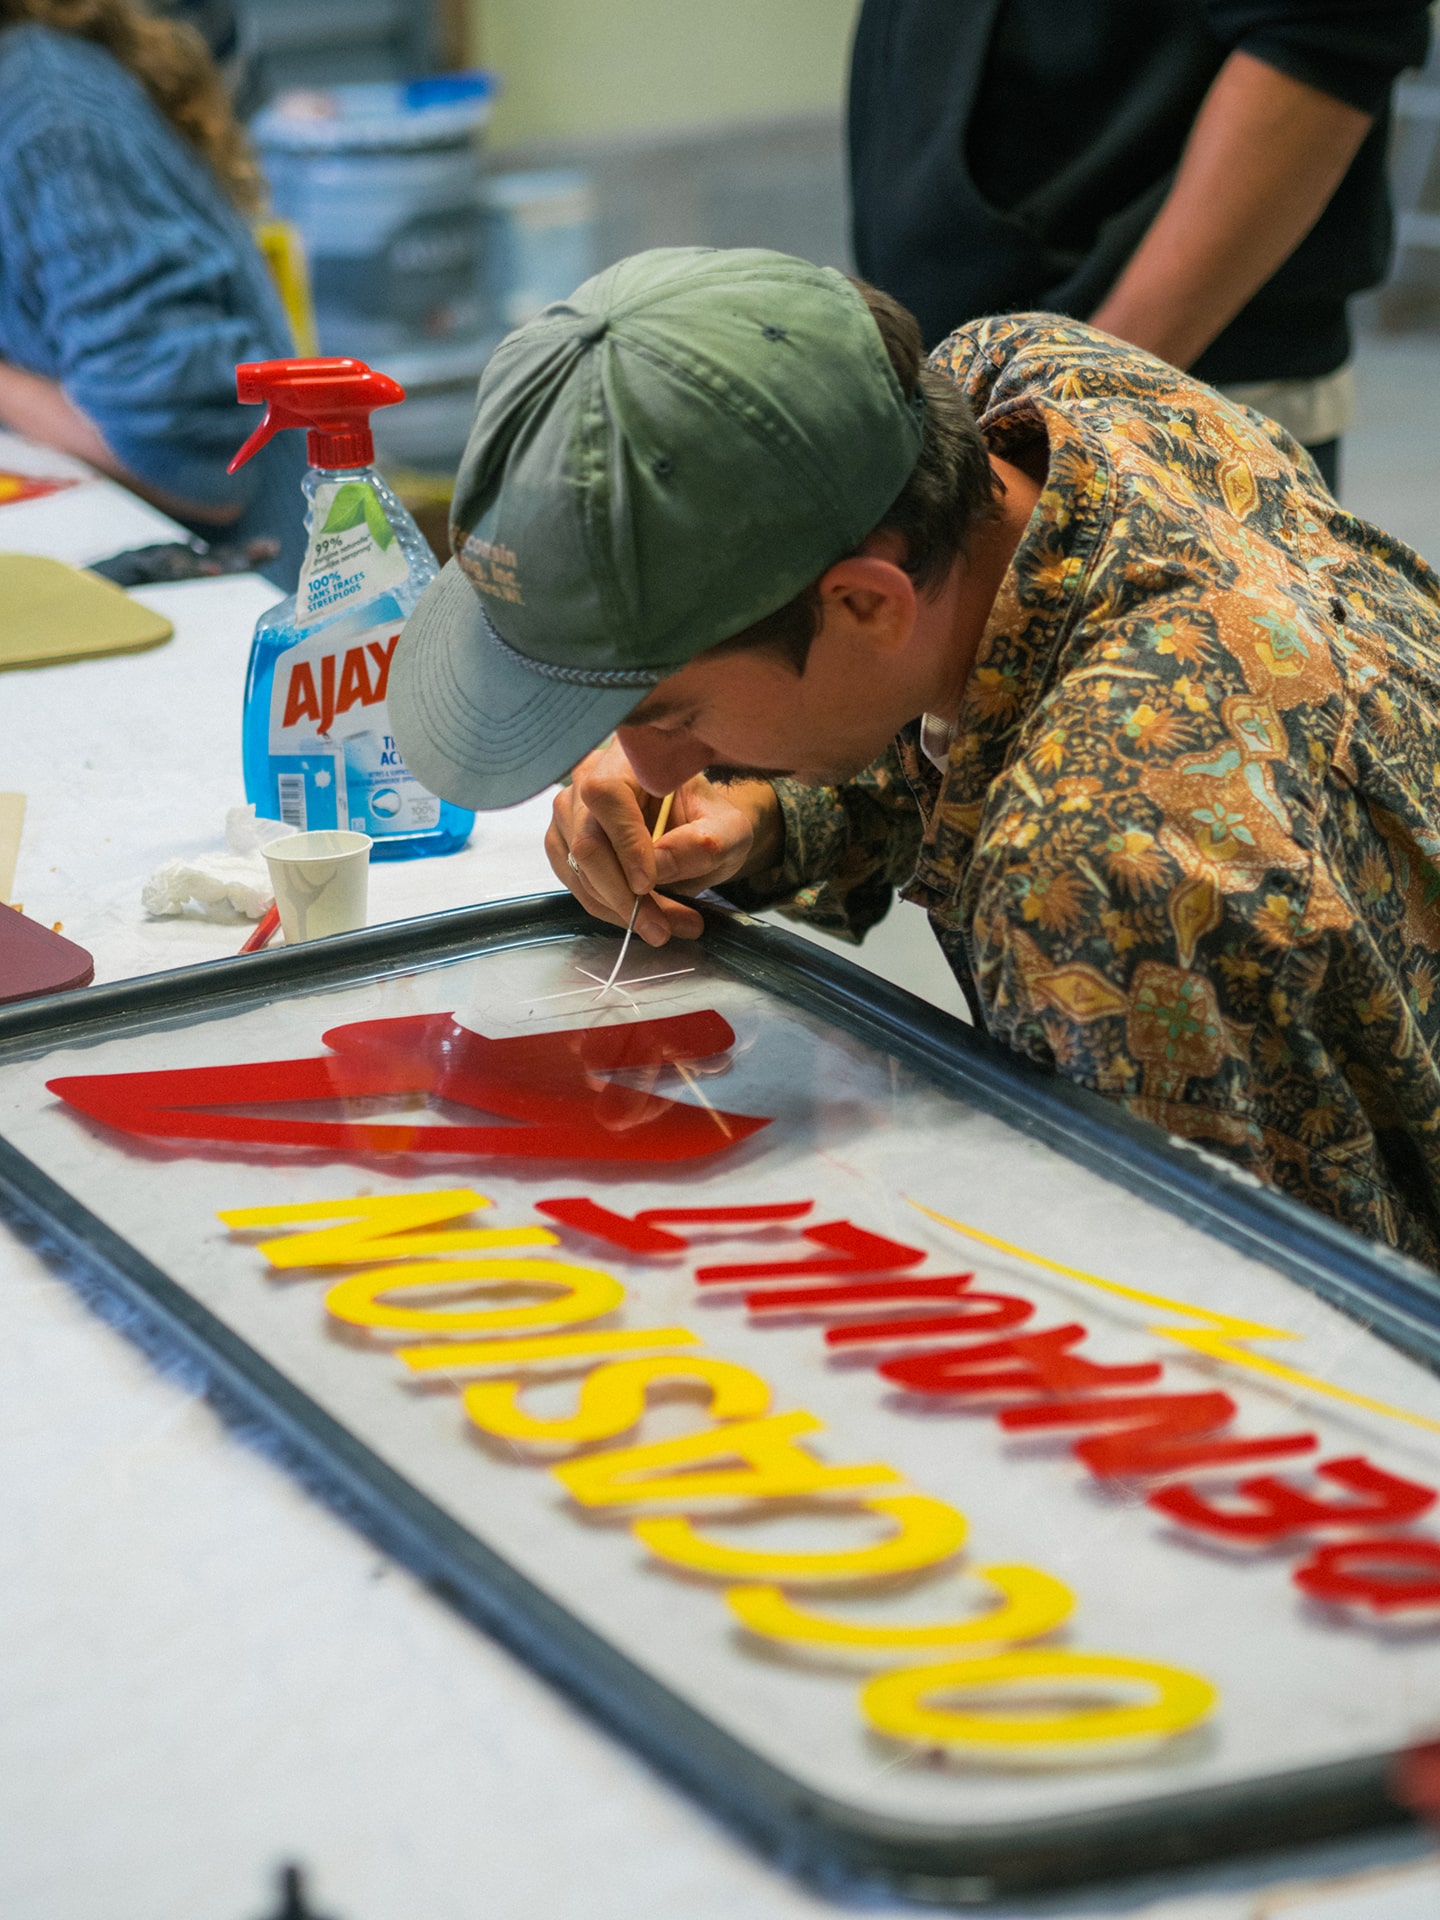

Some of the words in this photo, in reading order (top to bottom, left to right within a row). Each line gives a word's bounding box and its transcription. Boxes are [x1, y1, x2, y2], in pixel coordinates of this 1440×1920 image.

[315, 536, 342, 557] 99%
[307, 571, 342, 593] 100%
[307, 582, 362, 612] STREEPLOOS
[308, 588, 330, 603] SANS
[333, 571, 366, 592] TRACES
[217, 1189, 1218, 1748] OCCASION
